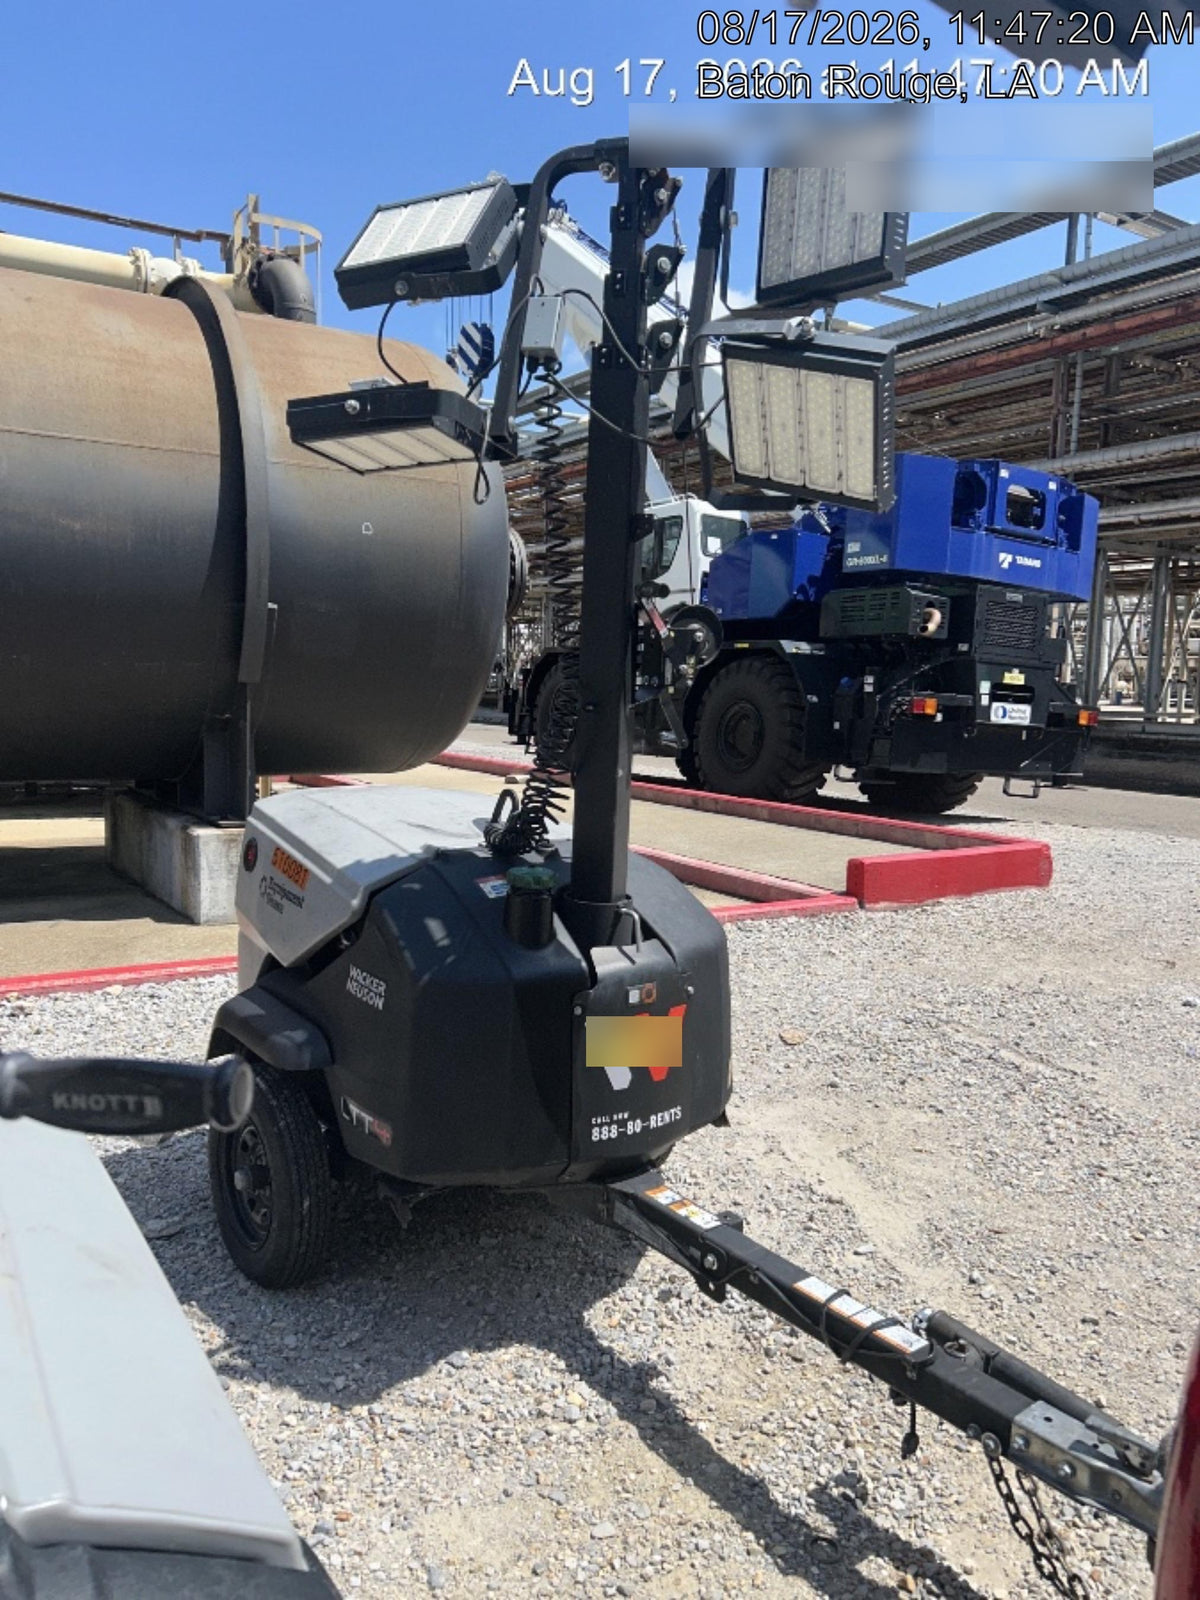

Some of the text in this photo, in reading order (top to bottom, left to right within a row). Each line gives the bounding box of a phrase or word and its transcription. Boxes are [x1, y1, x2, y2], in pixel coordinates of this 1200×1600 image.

[346, 977, 385, 1011] NEUSON
[350, 963, 386, 996] WACKER
[52, 1092, 139, 1113] KNOTT
[591, 1114, 611, 1125] CALL
[591, 1105, 682, 1142] 888-80-RENTS
